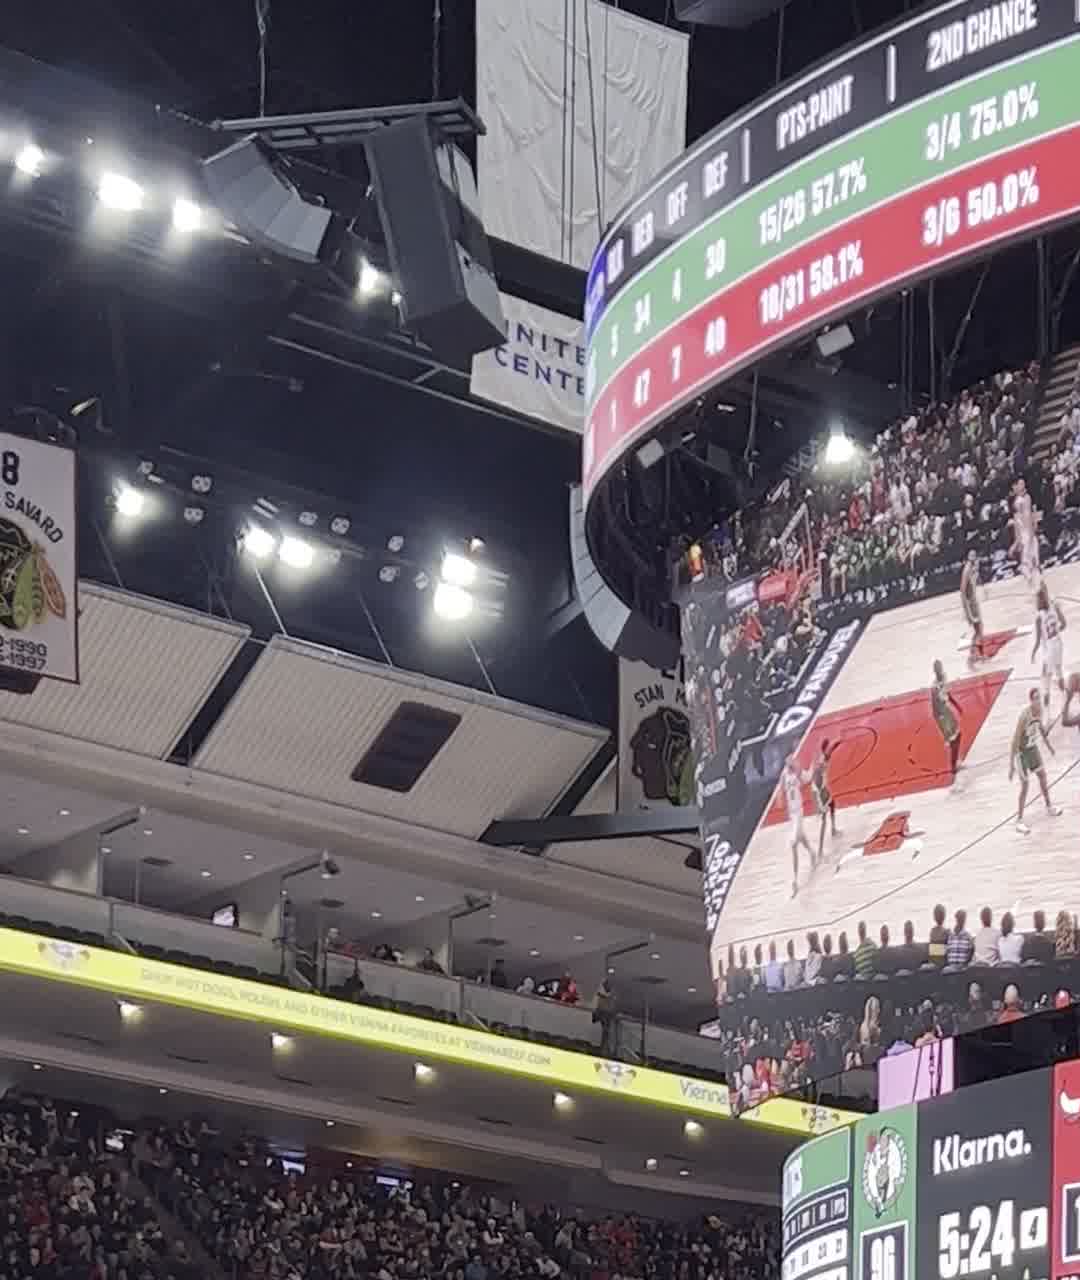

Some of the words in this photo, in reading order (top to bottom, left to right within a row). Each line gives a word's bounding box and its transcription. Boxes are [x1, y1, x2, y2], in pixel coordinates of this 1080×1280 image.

[926, 29, 965, 72] 2ND
[965, 0, 1038, 53] CHANCE
[776, 75, 854, 151] PTS-PAINT
[924, 111, 961, 160] 3/4
[968, 81, 1040, 142] 75.0%
[703, 151, 729, 198] DEF
[810, 156, 868, 218] 57.7%
[920, 196, 961, 247] 3/6
[966, 165, 1040, 228] 50.0%
[808, 240, 865, 299] 58.1%
[4, 491, 64, 544] SAVARD
[932, 1128, 1033, 1177] Klarna.
[938, 1199, 1016, 1279] 5:24
